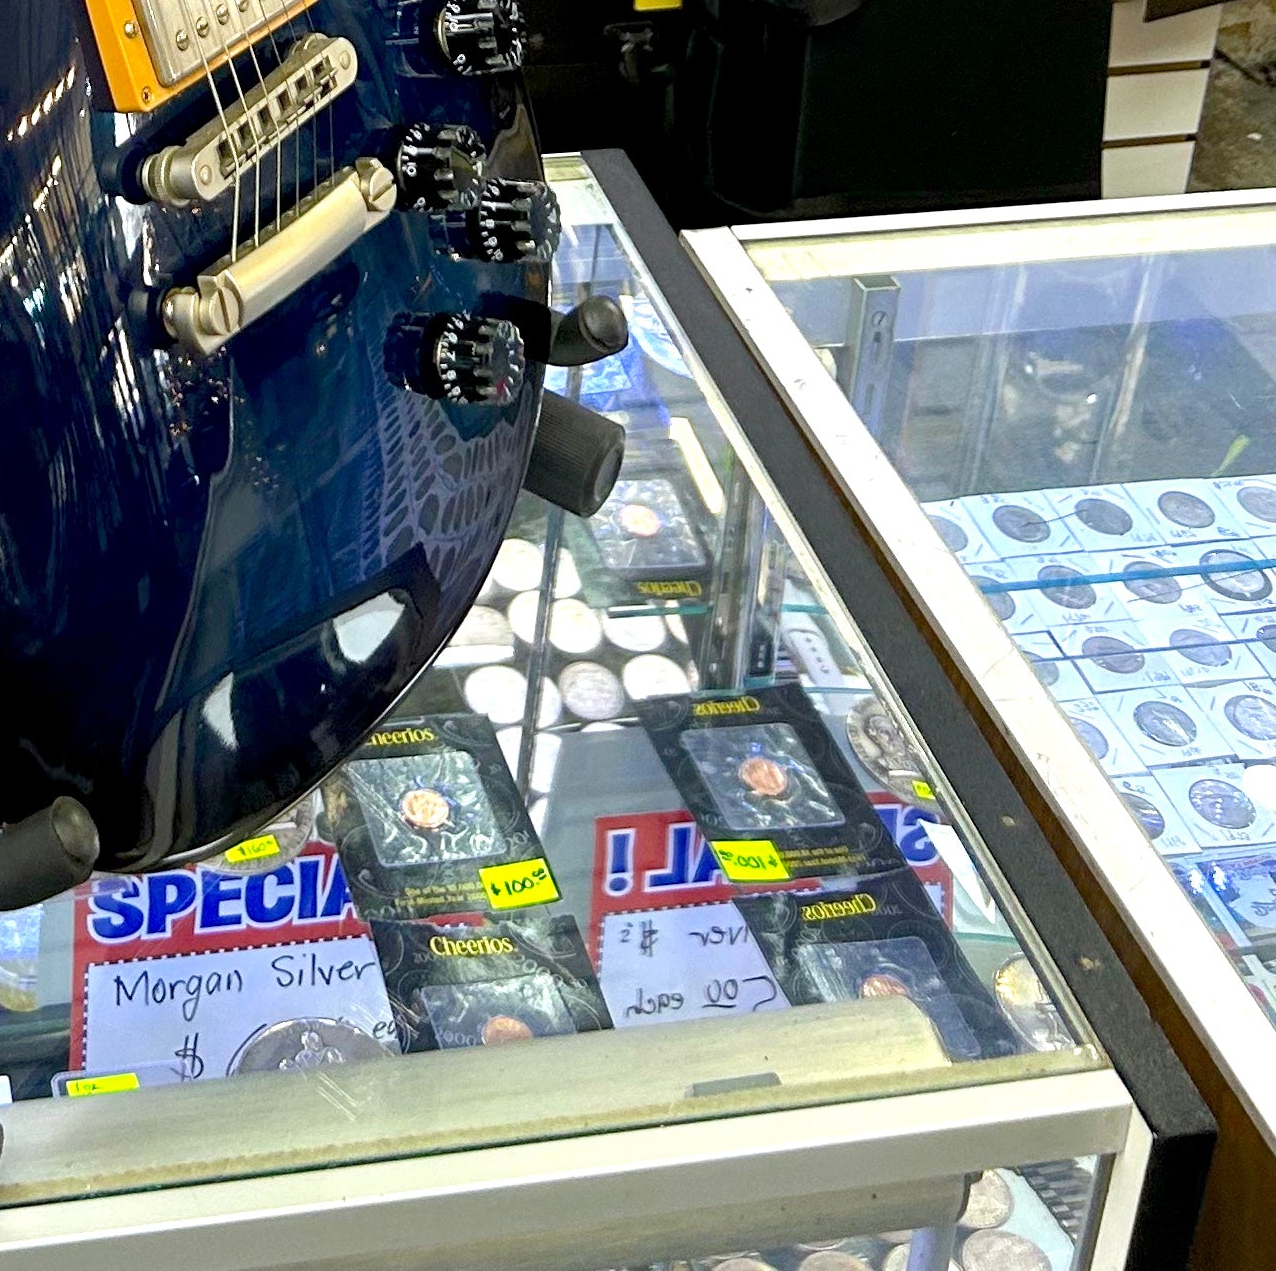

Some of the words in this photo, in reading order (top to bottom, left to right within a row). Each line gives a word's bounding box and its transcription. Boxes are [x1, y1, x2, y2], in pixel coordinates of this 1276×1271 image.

[365, 728, 435, 746] heerios
[429, 935, 515, 957] Cheerios
[113, 969, 243, 1021] Morgan
[271, 952, 376, 988] Silver
